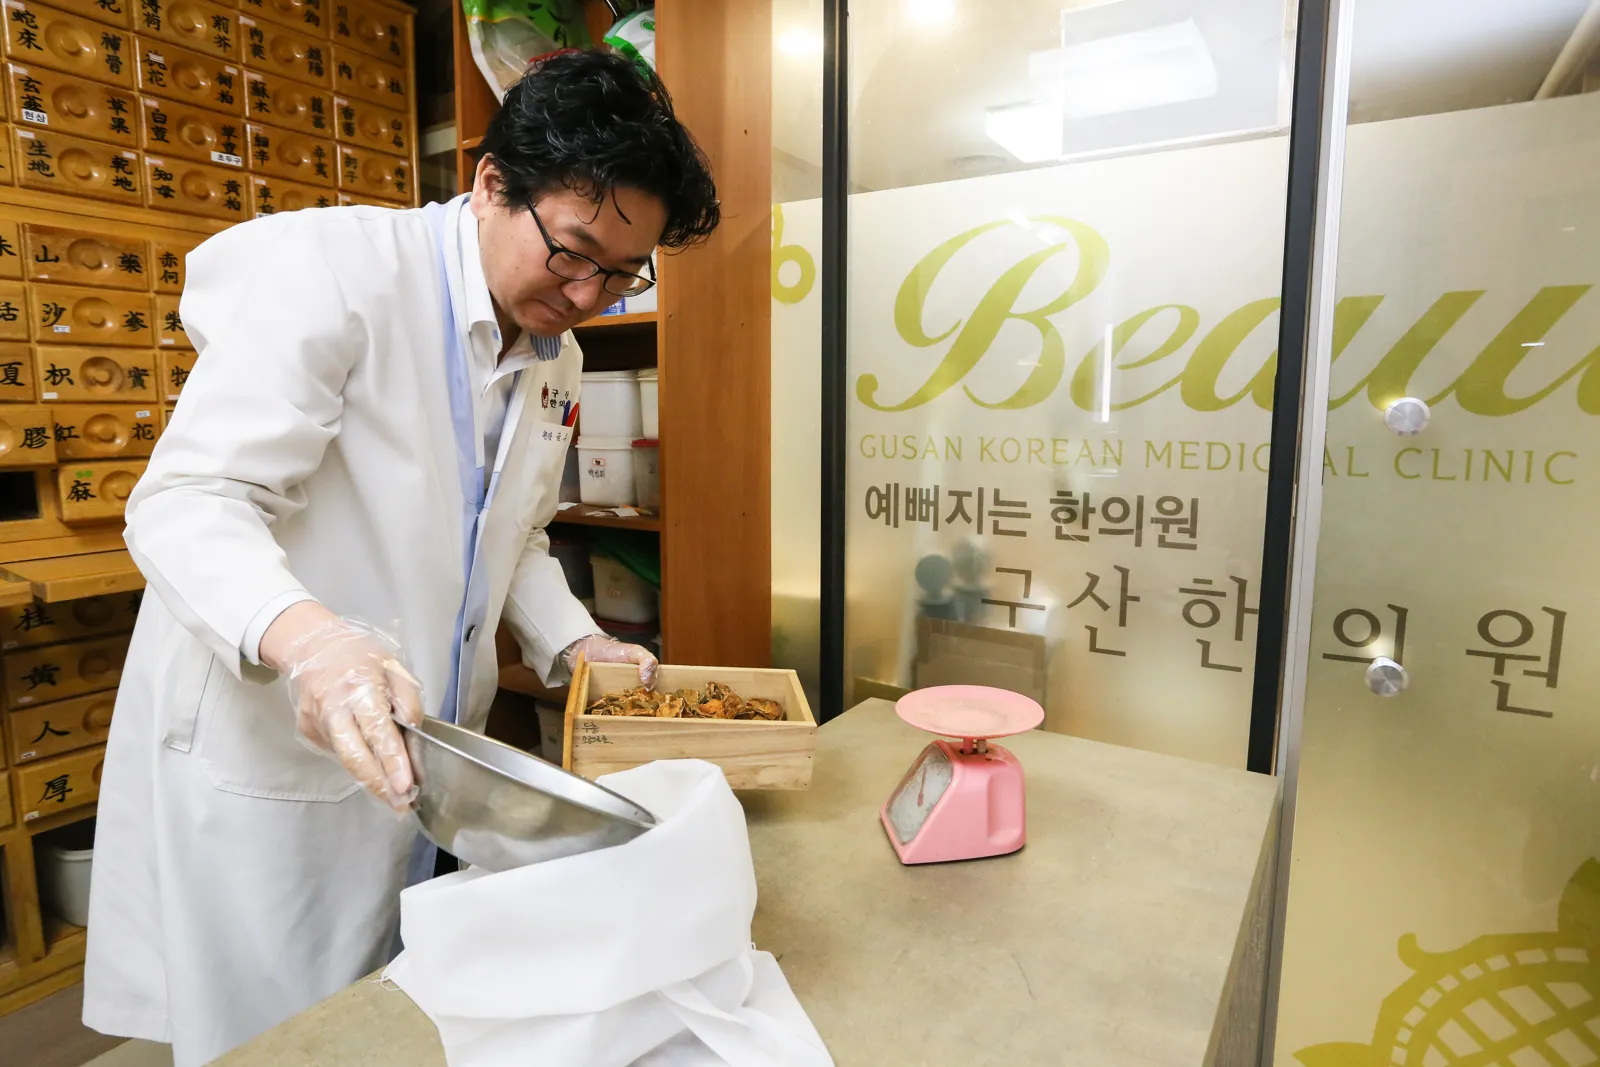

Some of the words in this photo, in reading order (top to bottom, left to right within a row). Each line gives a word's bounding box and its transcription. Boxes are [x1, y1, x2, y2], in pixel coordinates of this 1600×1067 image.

[25, 110, 46, 123] 현삼
[27, 140, 55, 178] 生地
[217, 154, 241, 165] 초두구
[153, 167, 175, 198] 知母
[35, 244, 60, 263] 山
[41, 303, 67, 327] 沙
[856, 214, 1600, 416] Beau
[19, 427, 51, 448] 膠
[860, 434, 963, 461] GUSAN
[978, 437, 1124, 467] KOREAN
[1394, 447, 1579, 485] CLINIC
[66, 480, 96, 502] 麻
[865, 482, 1032, 538] 예뻐지는
[1049, 489, 1200, 551] 한의원
[31, 721, 71, 744] 人
[37, 774, 73, 804] 厚
